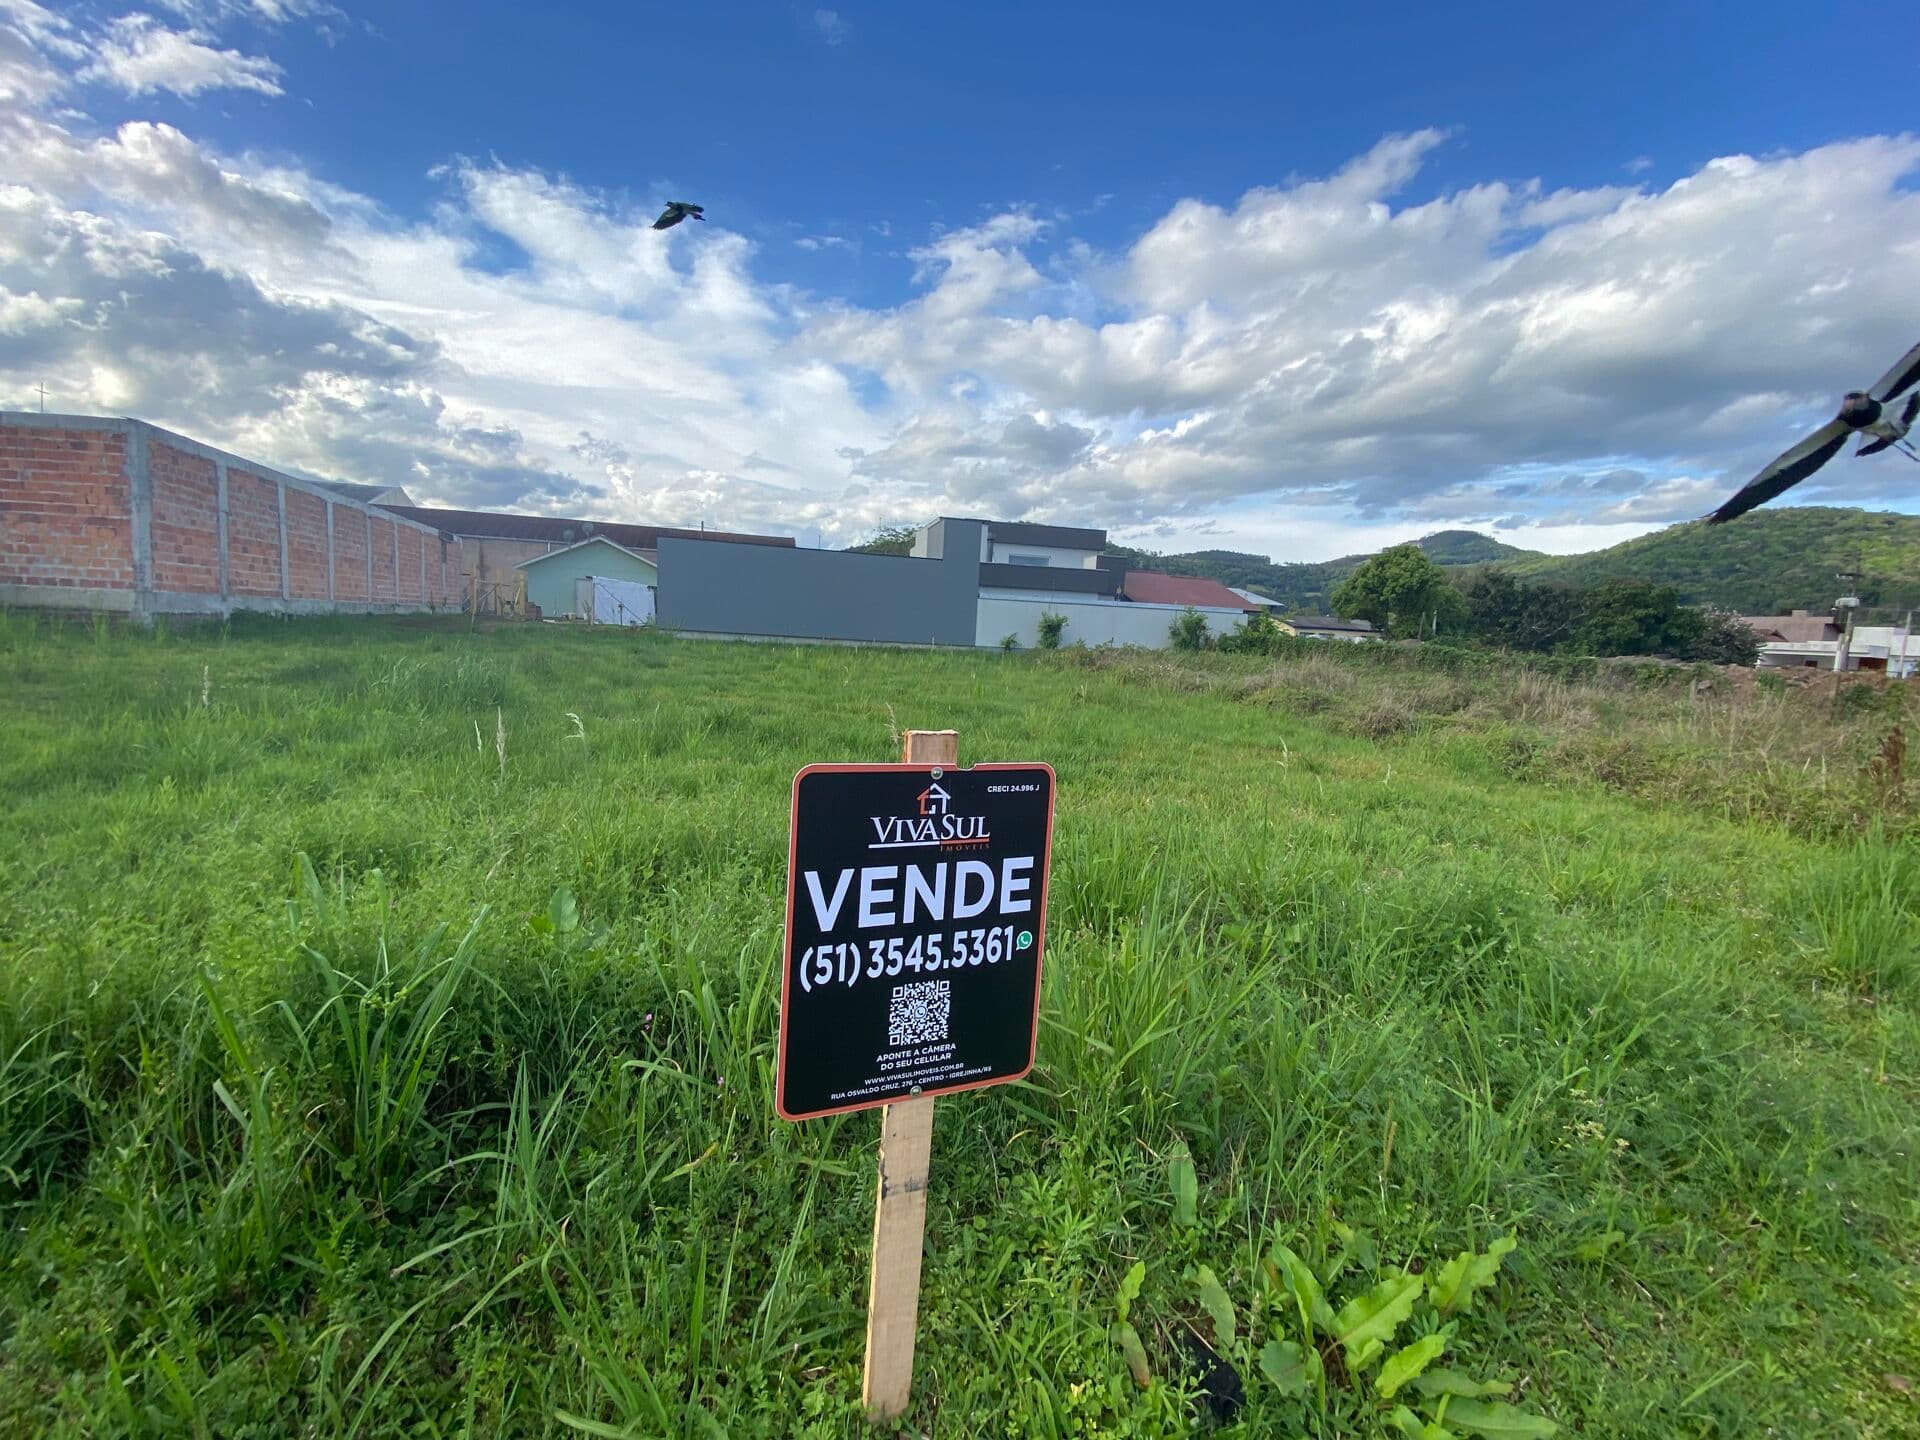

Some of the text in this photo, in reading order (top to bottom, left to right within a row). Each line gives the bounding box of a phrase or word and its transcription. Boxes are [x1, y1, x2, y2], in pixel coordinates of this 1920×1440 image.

[987, 785, 1009, 793] CRECI
[804, 856, 1034, 933] VENDE
[800, 925, 1014, 993] (51) 3545.5361
[876, 1050, 912, 1062] APONTE
[922, 1042, 956, 1055] CÂMERA
[881, 1053, 952, 1071] DO SEU CELULAR
[847, 1086, 880, 1097] OSVALDO
[919, 1074, 945, 1084] CENTRO
[950, 1065, 993, 1079] IGREJINHA/RS
